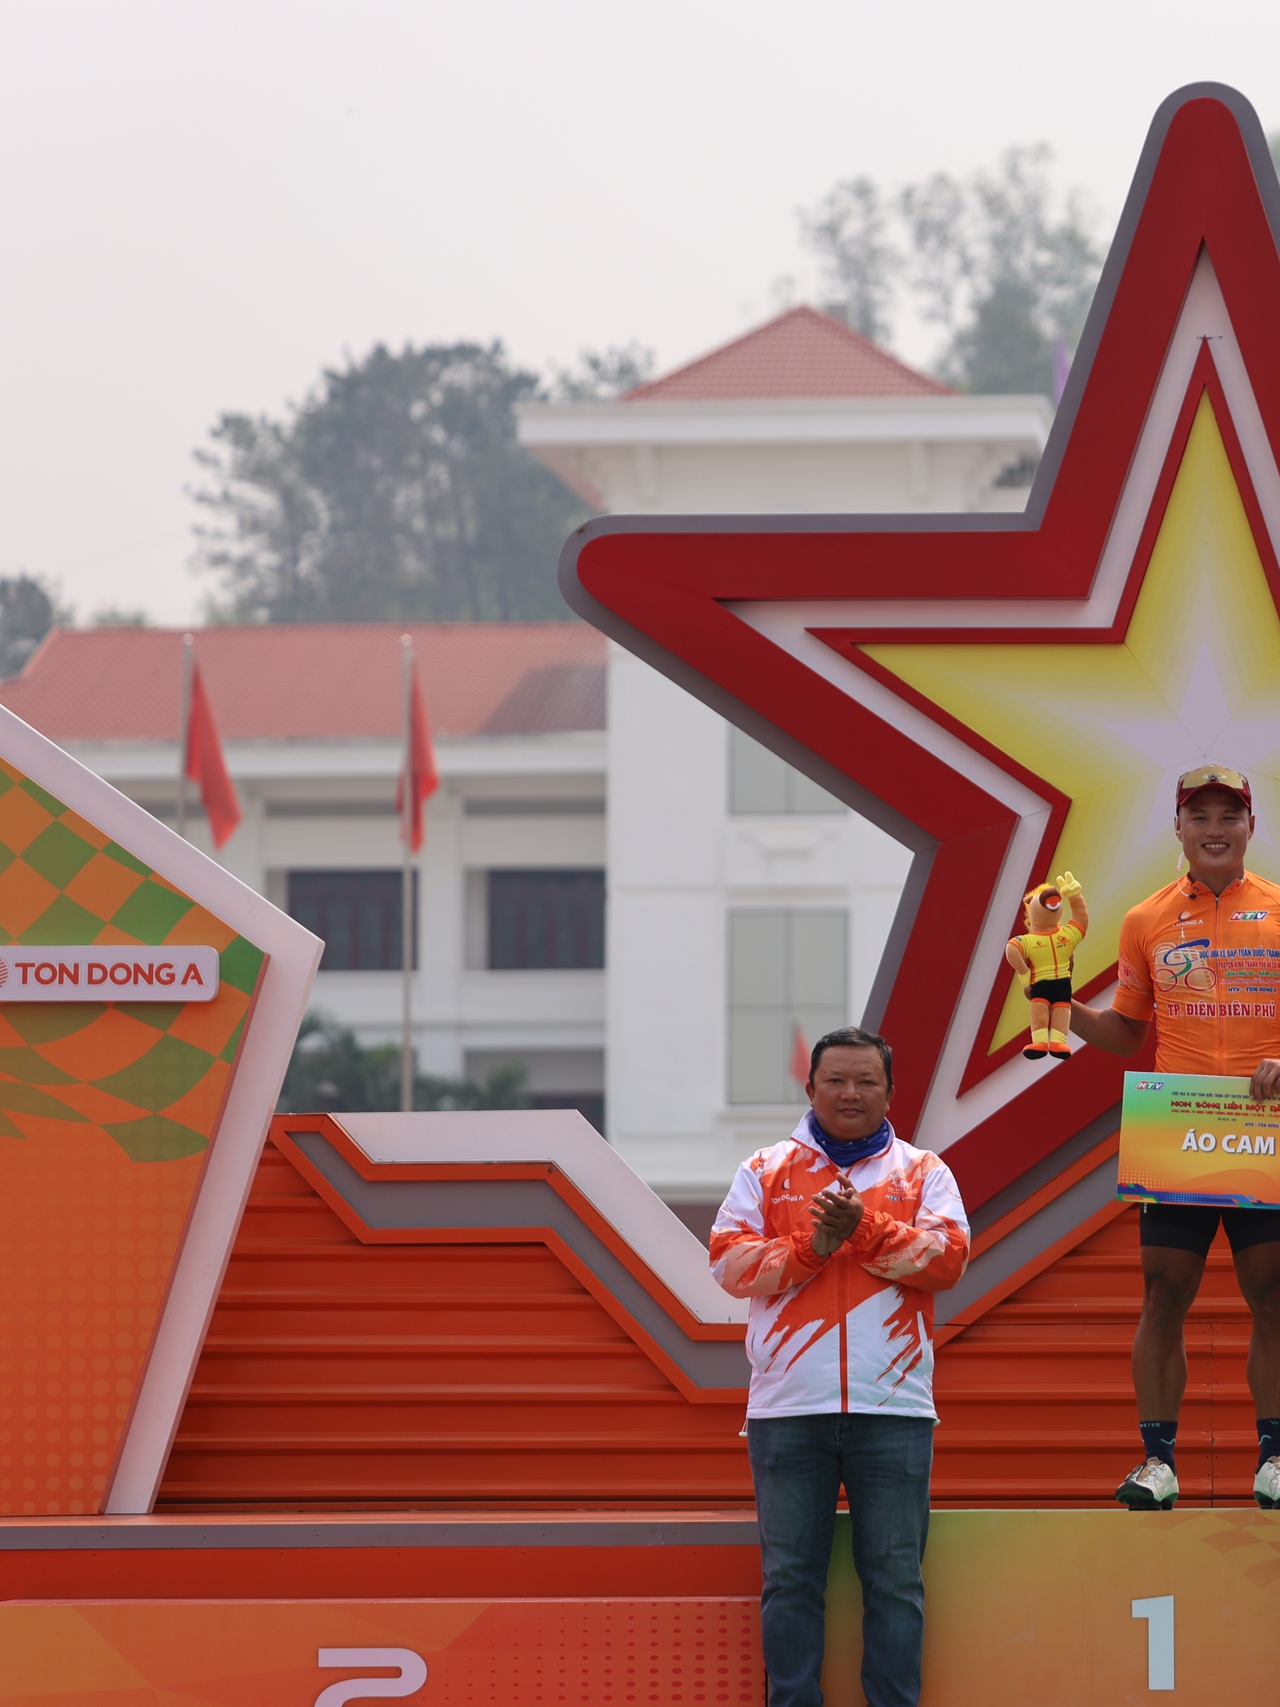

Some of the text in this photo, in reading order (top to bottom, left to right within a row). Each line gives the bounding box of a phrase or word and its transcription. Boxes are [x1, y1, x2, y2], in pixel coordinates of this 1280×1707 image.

[1230, 911, 1266, 920] HTV
[15, 962, 204, 986] TON DONG A
[1167, 1000, 1277, 1019] TP. ĐIỆN BIÊN PHỦ
[1137, 1081, 1163, 1090] HTV
[1195, 1100, 1220, 1110] SÔNG
[1181, 1128, 1277, 1156] ÁO CAM
[1132, 1594, 1175, 1690] 1
